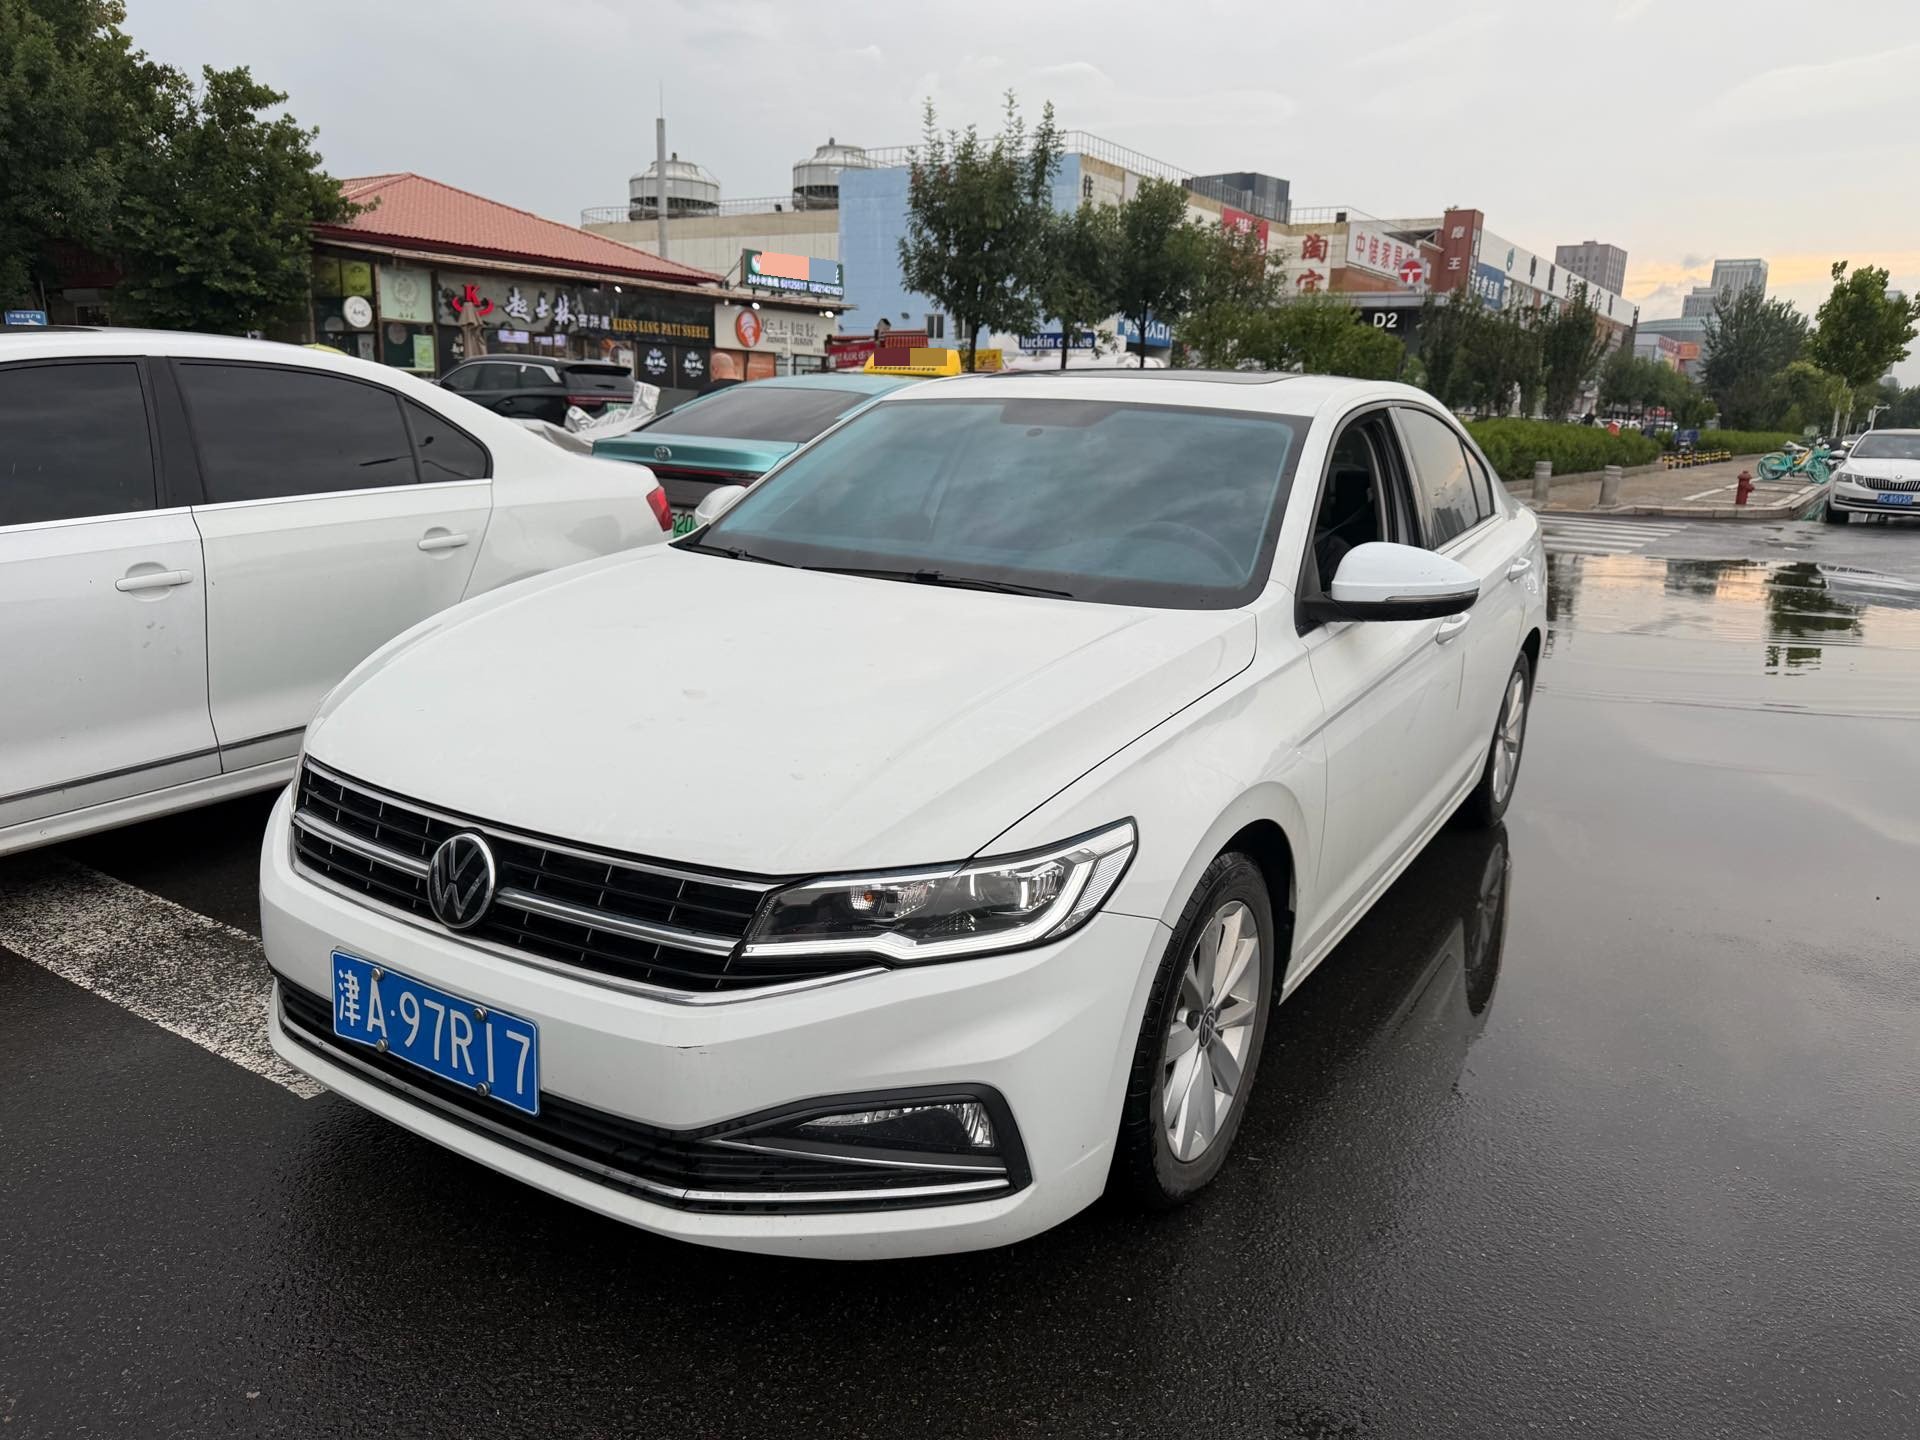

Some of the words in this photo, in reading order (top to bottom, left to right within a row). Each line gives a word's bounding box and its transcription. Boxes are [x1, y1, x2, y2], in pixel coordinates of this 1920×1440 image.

[1373, 312, 1398, 329] D2
[1021, 335, 1055, 348] luckin
[338, 969, 531, 1096] 津A·97R17
